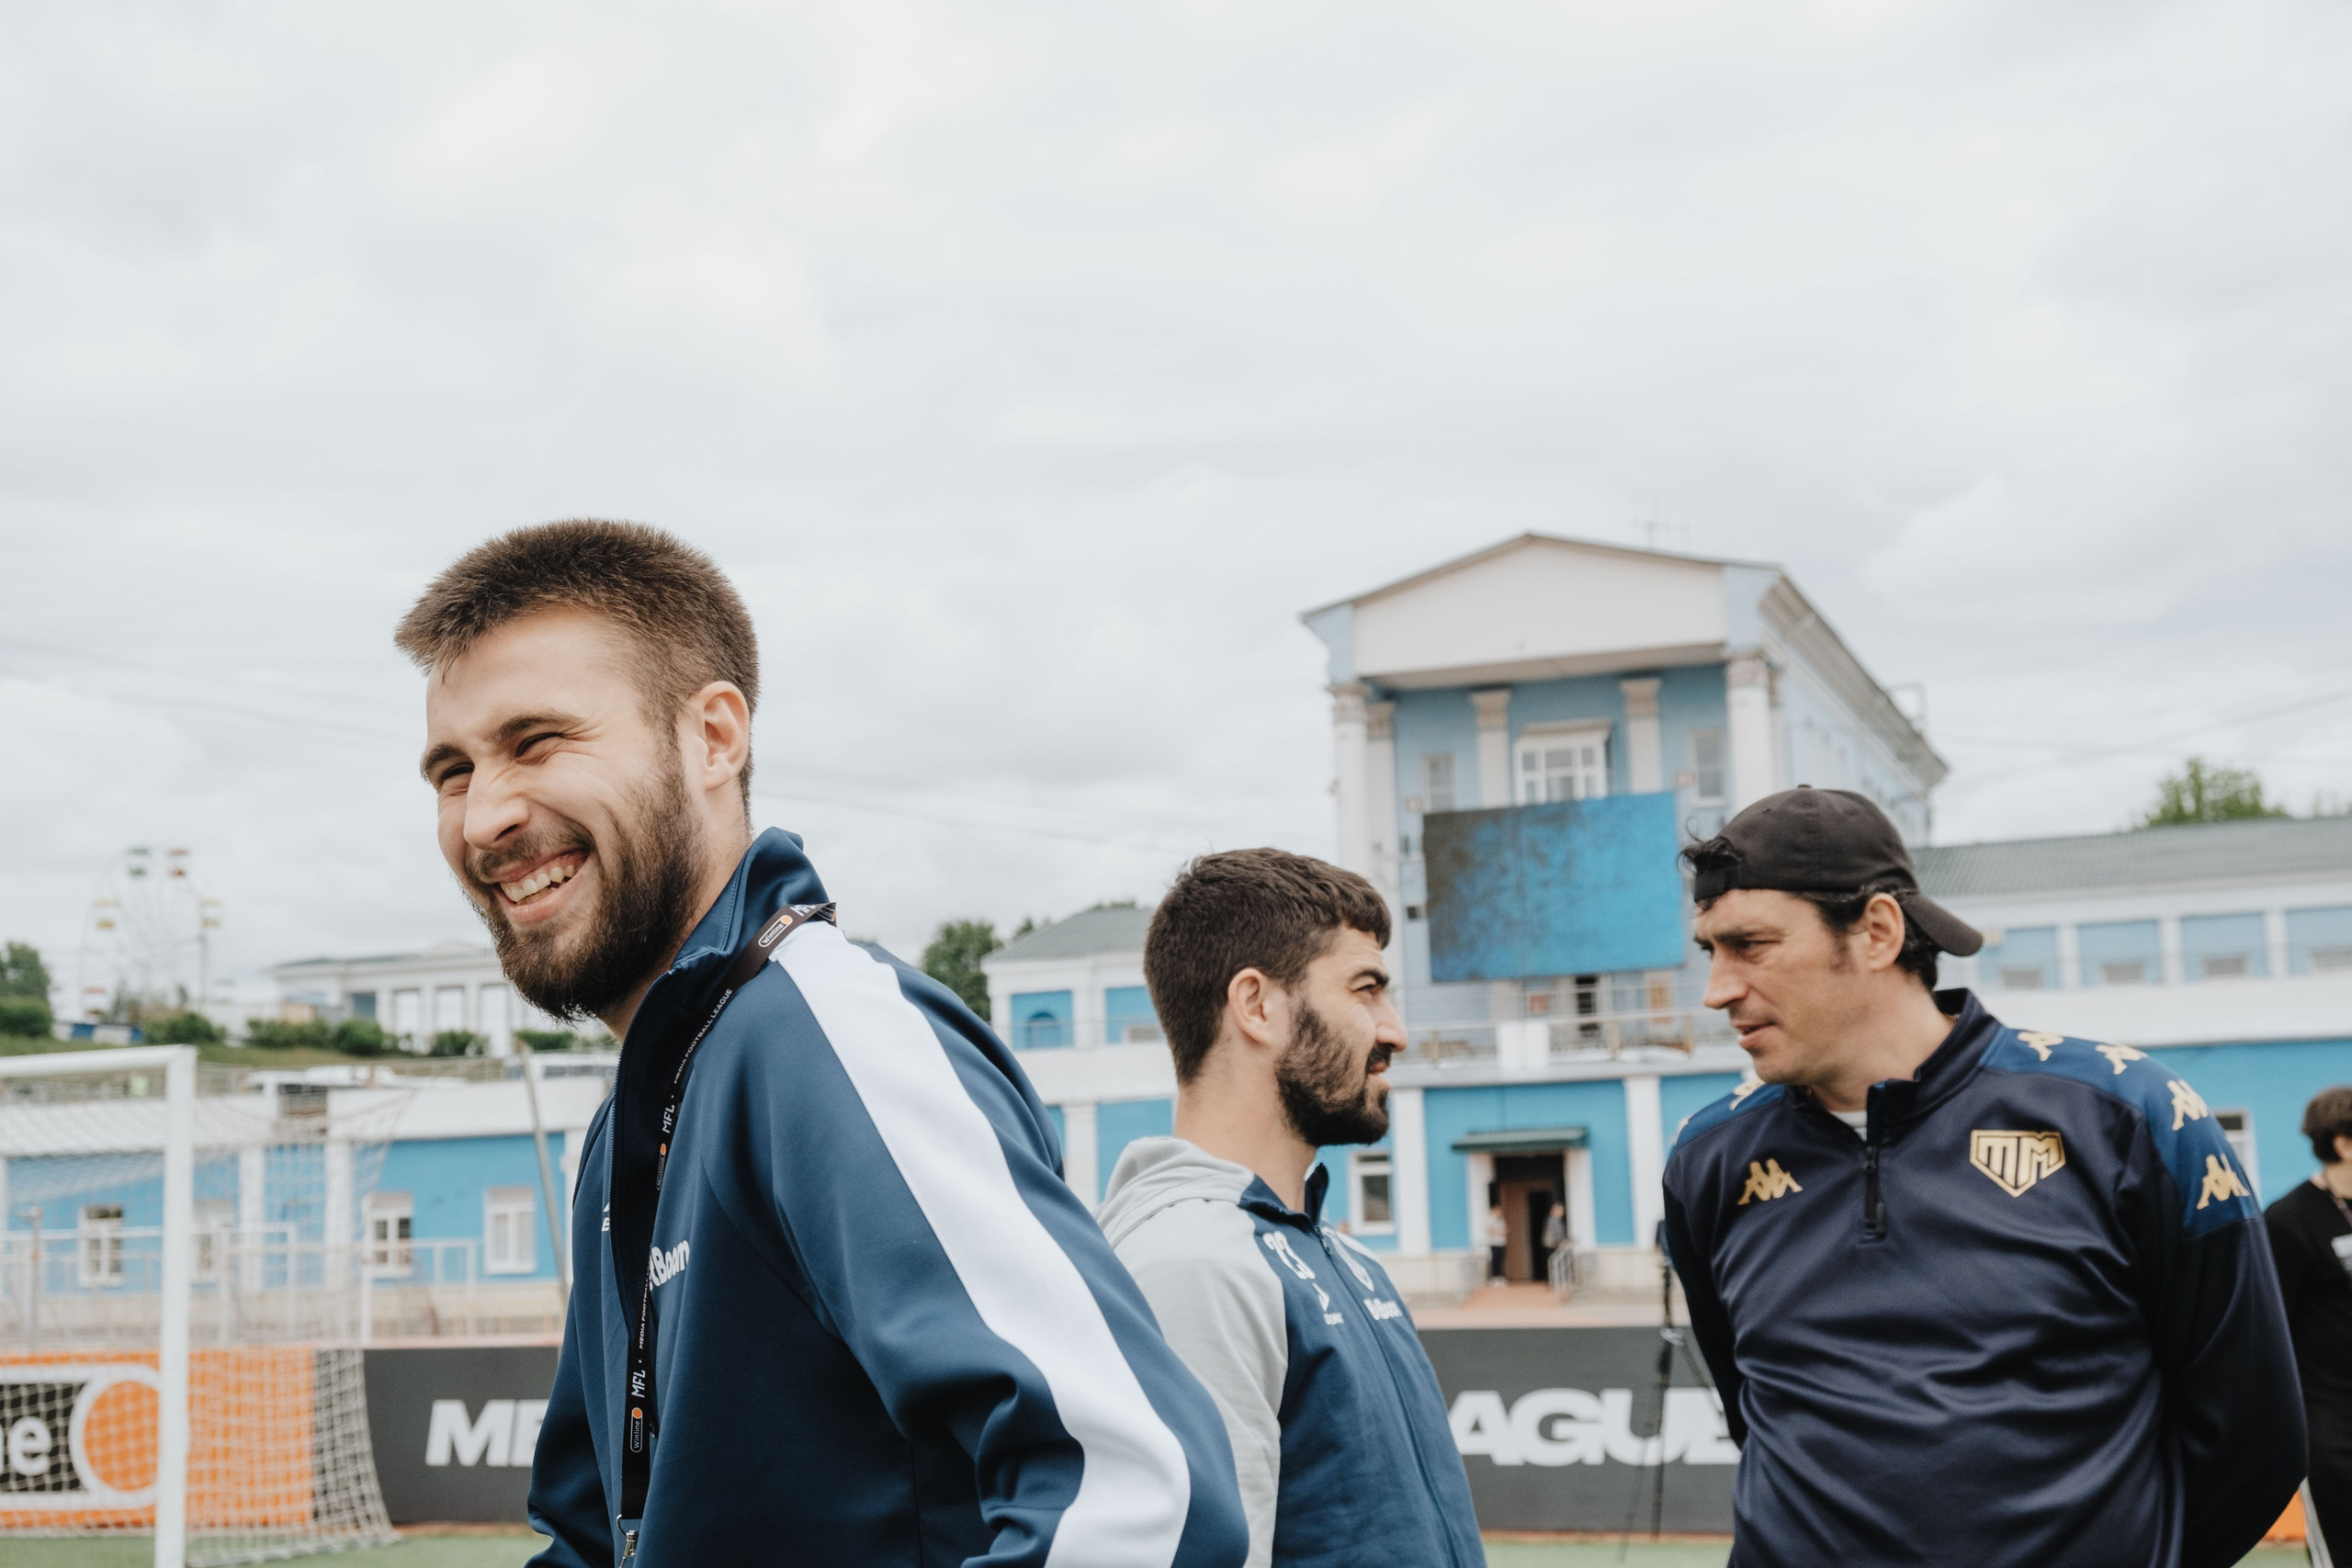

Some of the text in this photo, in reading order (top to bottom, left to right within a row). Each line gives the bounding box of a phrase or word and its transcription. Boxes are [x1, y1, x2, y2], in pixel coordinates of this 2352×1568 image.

[761, 923, 785, 944] Winline
[674, 987, 733, 1084] MEDIA FOOTBALL LEAGUE
[662, 1104, 675, 1134] MFL
[631, 1370, 646, 1398] MFL
